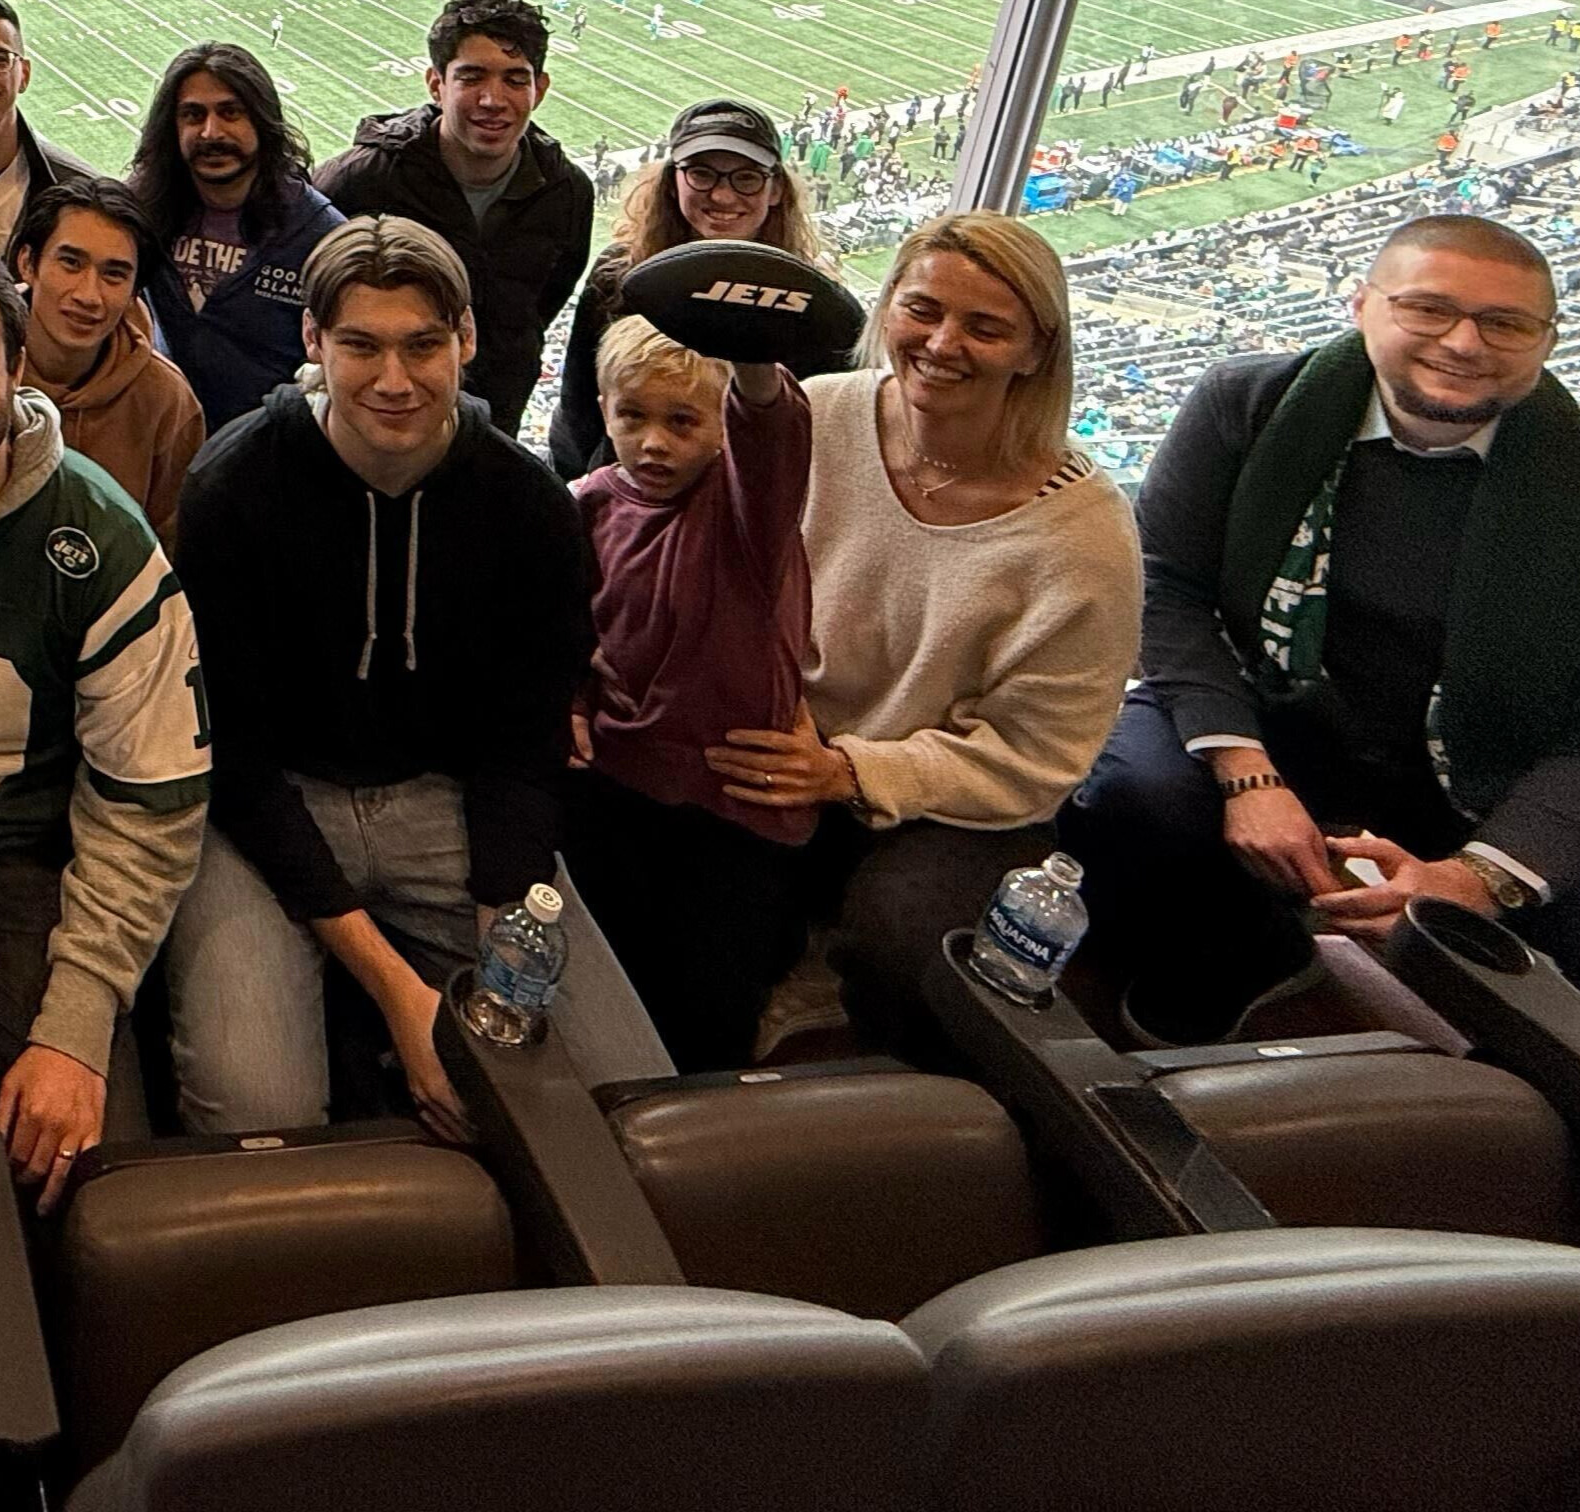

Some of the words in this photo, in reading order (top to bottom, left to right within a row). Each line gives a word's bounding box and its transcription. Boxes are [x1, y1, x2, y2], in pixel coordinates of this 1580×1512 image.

[172, 235, 203, 266] DE
[204, 239, 248, 274] THE
[254, 276, 305, 297] ISLAN
[260, 264, 304, 287] GOO
[690, 280, 814, 314] JETS
[53, 539, 89, 564] JETS
[988, 906, 1052, 963] AQUAFINA
